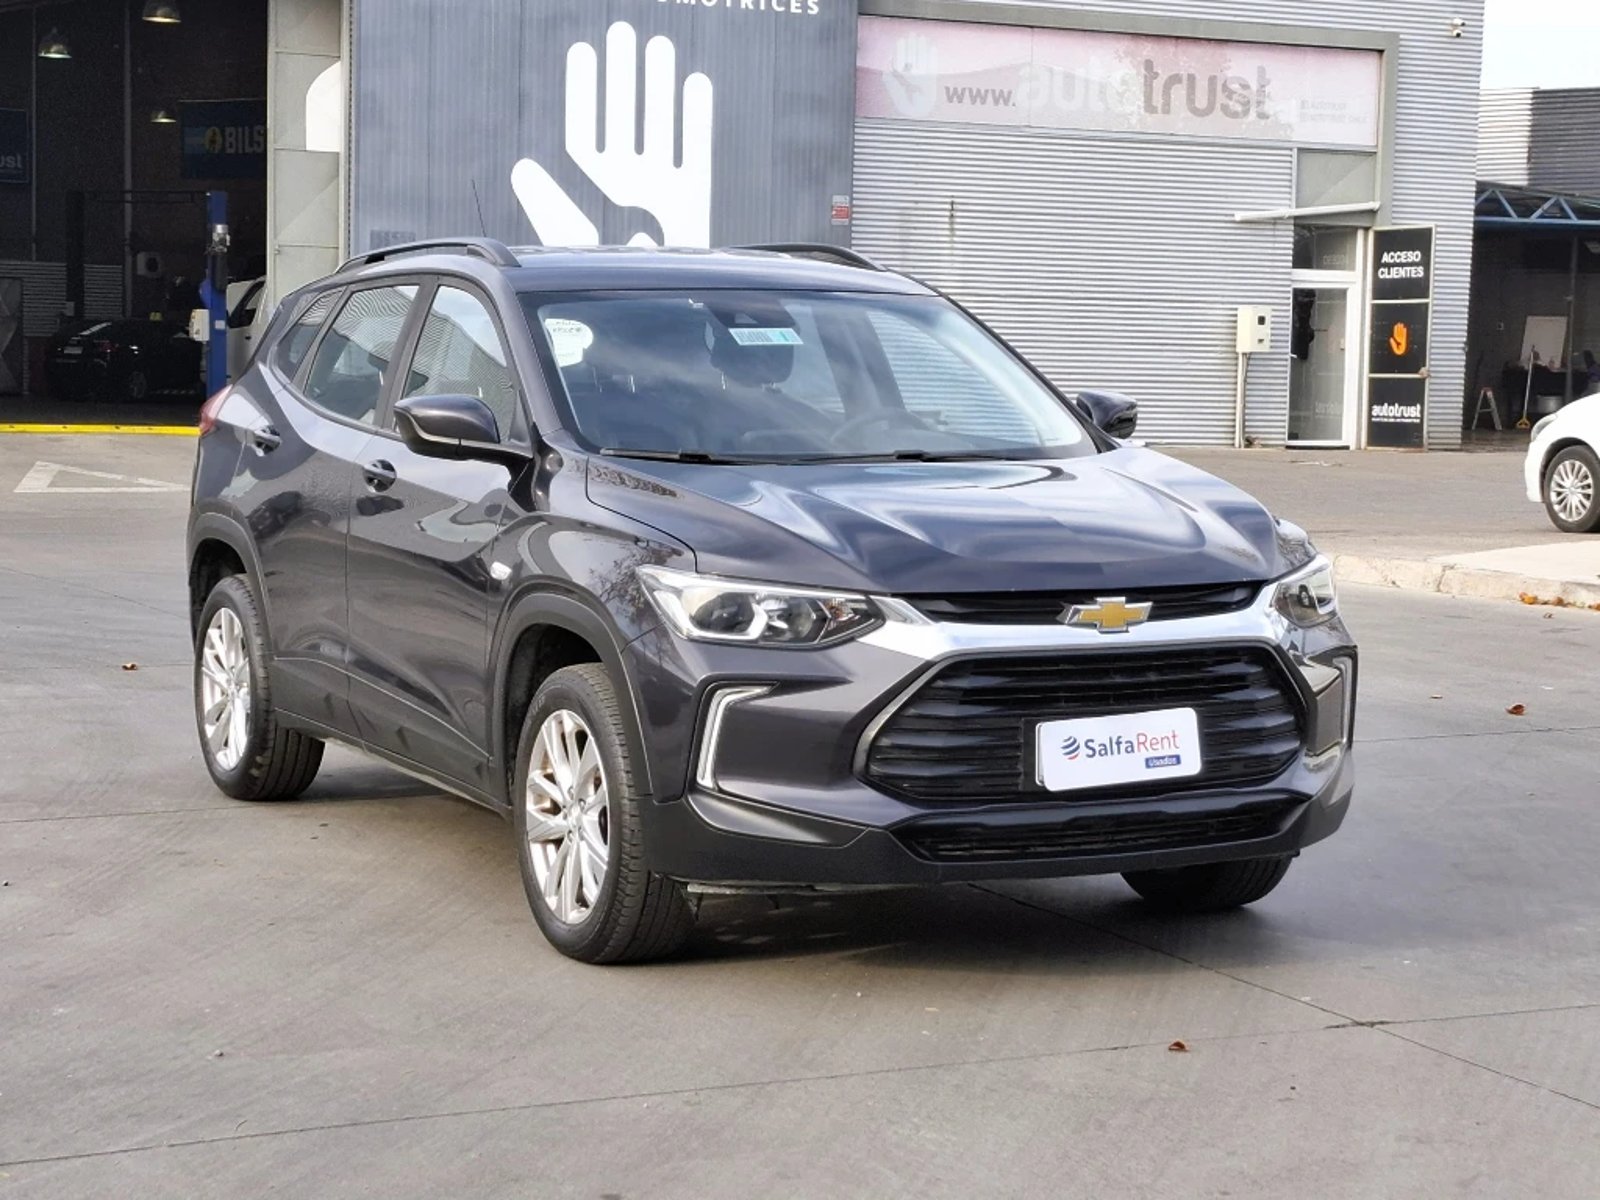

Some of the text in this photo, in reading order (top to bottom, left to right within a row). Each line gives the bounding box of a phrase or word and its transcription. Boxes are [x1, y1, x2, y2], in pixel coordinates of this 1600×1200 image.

[1381, 250, 1422, 263] ACCESO
[1378, 265, 1424, 279] CLIENTES
[1372, 402, 1421, 417] autotrust
[1084, 729, 1180, 759] SalfaRent
